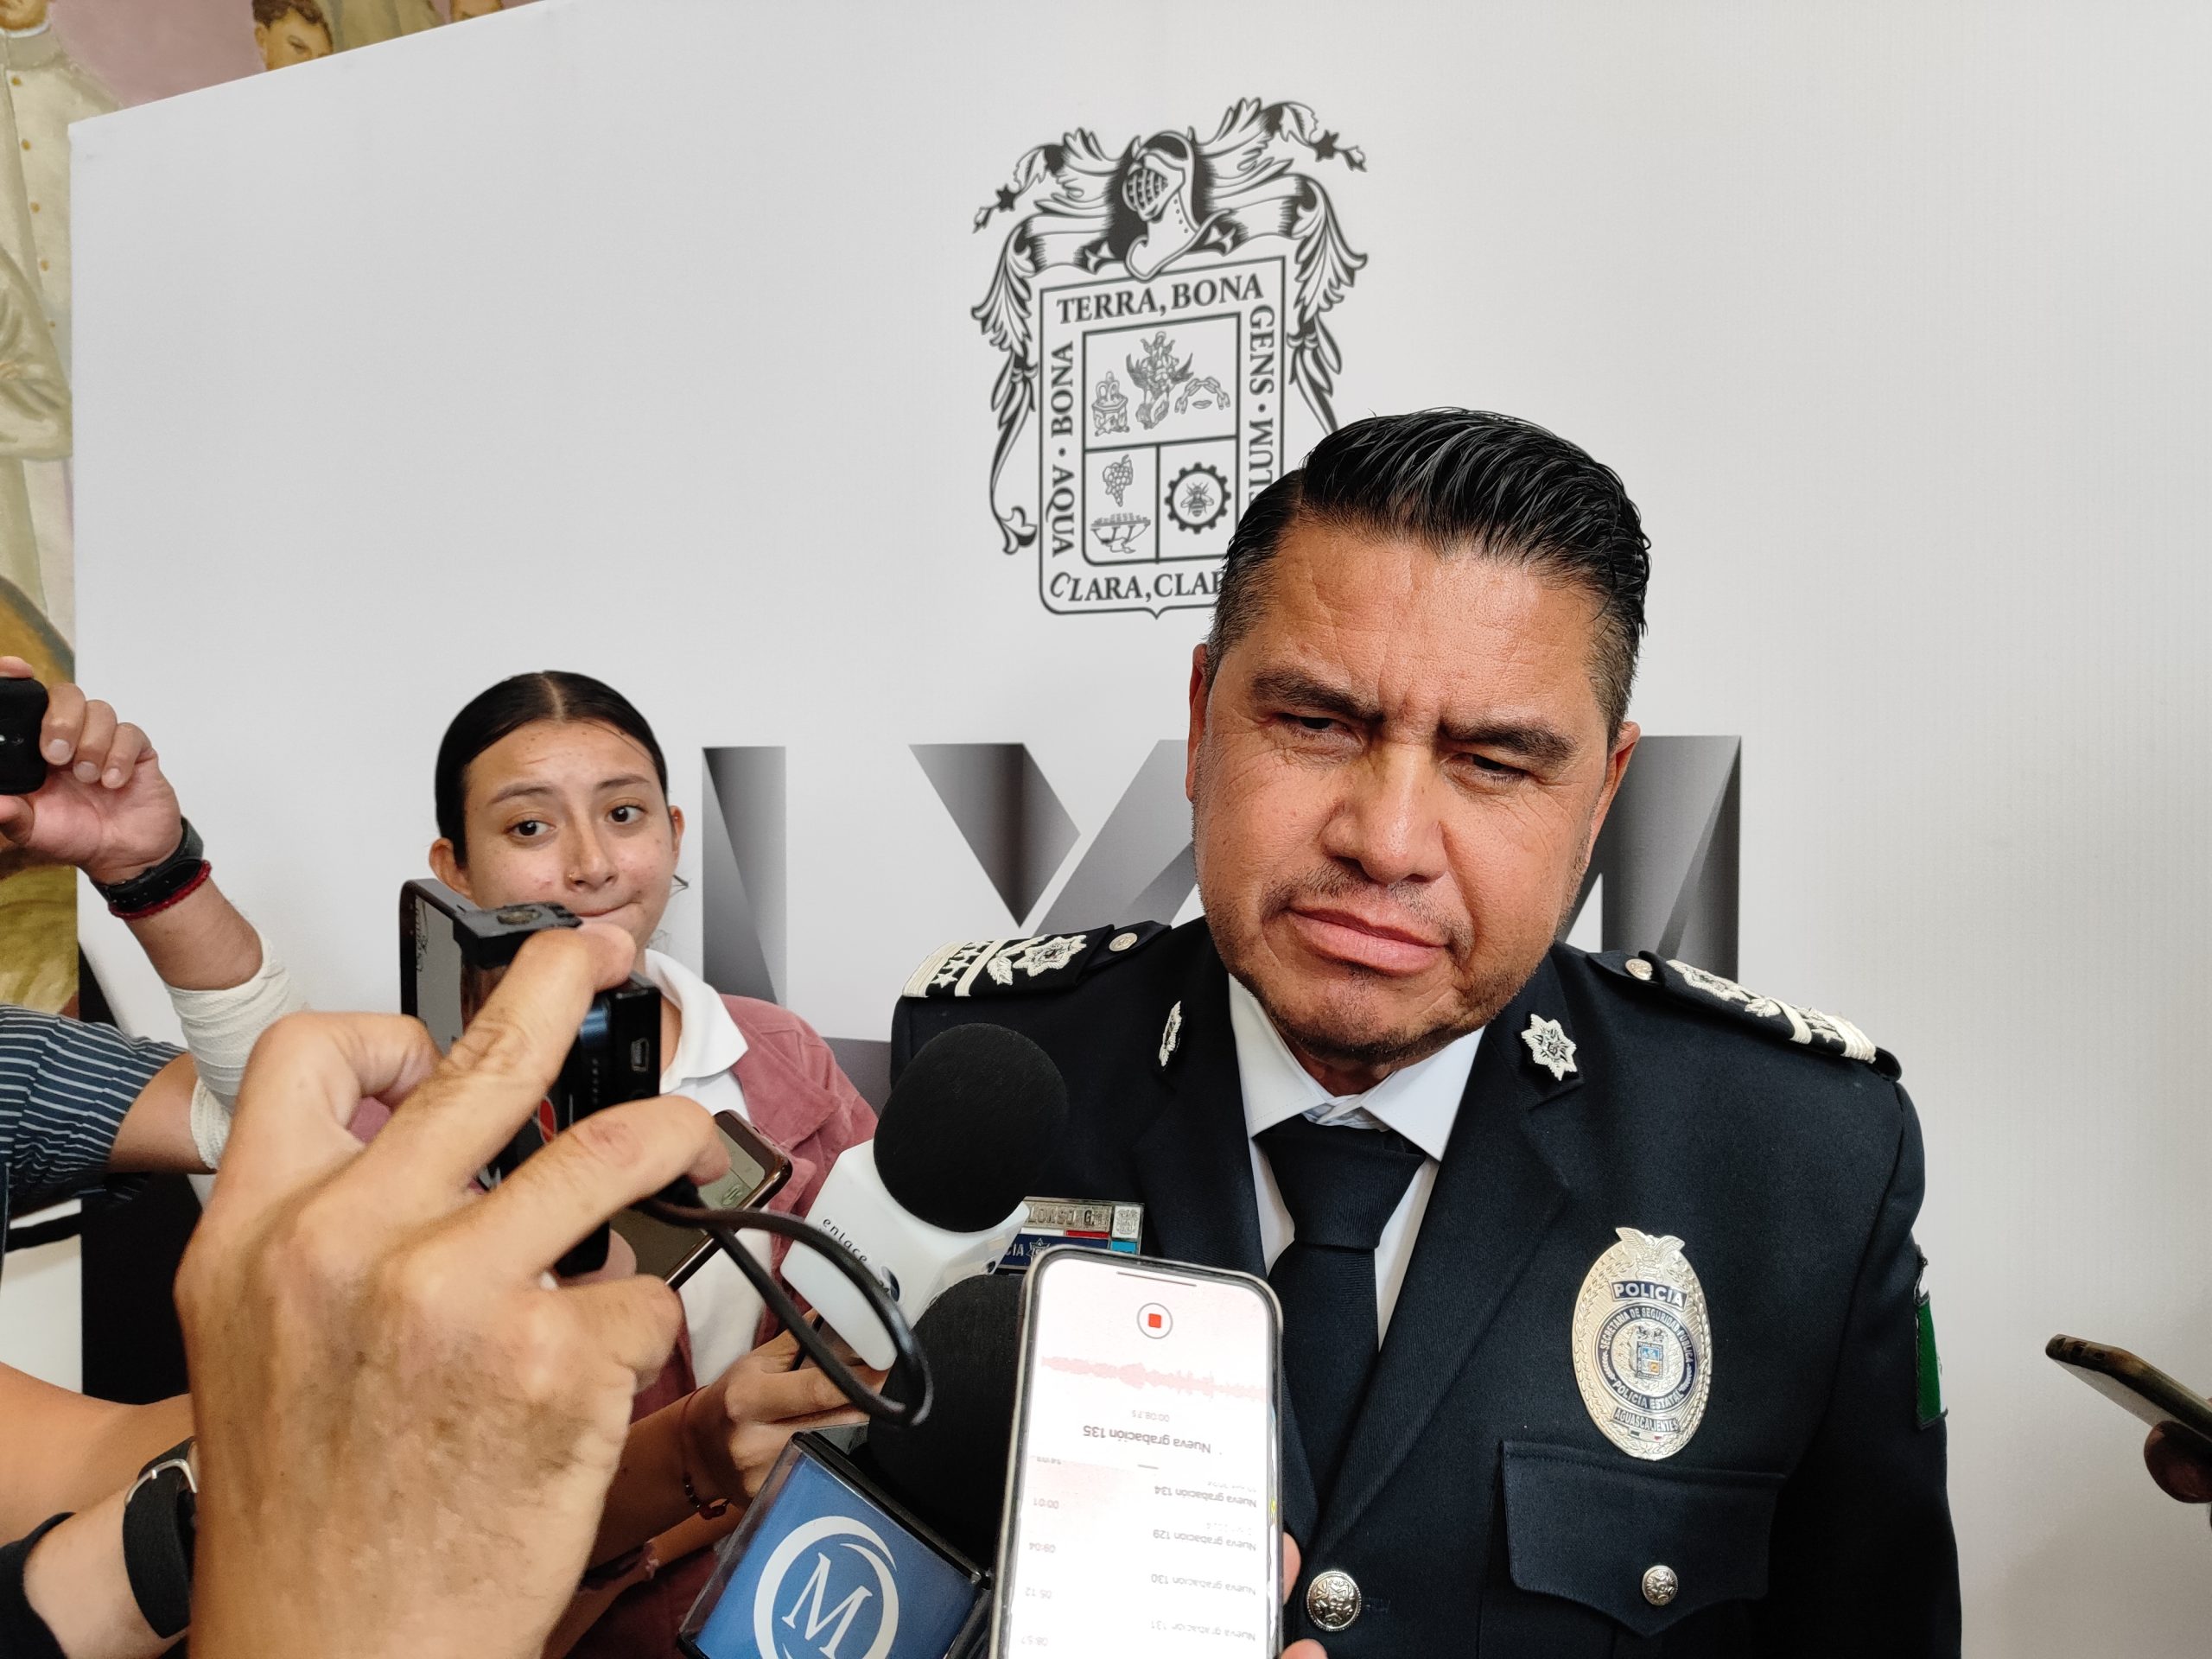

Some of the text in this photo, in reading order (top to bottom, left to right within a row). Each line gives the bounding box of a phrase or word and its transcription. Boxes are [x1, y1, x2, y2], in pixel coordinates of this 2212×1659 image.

[1056, 273, 1264, 325] TERRA, BONA
[1249, 304, 1275, 397] GENS
[1050, 340, 1074, 437] BONA
[1045, 464, 1075, 557] AQUA
[1050, 571, 1152, 603] CLARA,
[823, 1218, 868, 1262] enlace
[1612, 1282, 1684, 1307] POLICIA
[1629, 1307, 1641, 1319] DE
[1642, 1306, 1681, 1332] SEGURIDAD
[1082, 1425, 1211, 1454] Nueva grabación 135
[1225, 1495, 1257, 1508] Nueva
[781, 1552, 874, 1659] M
